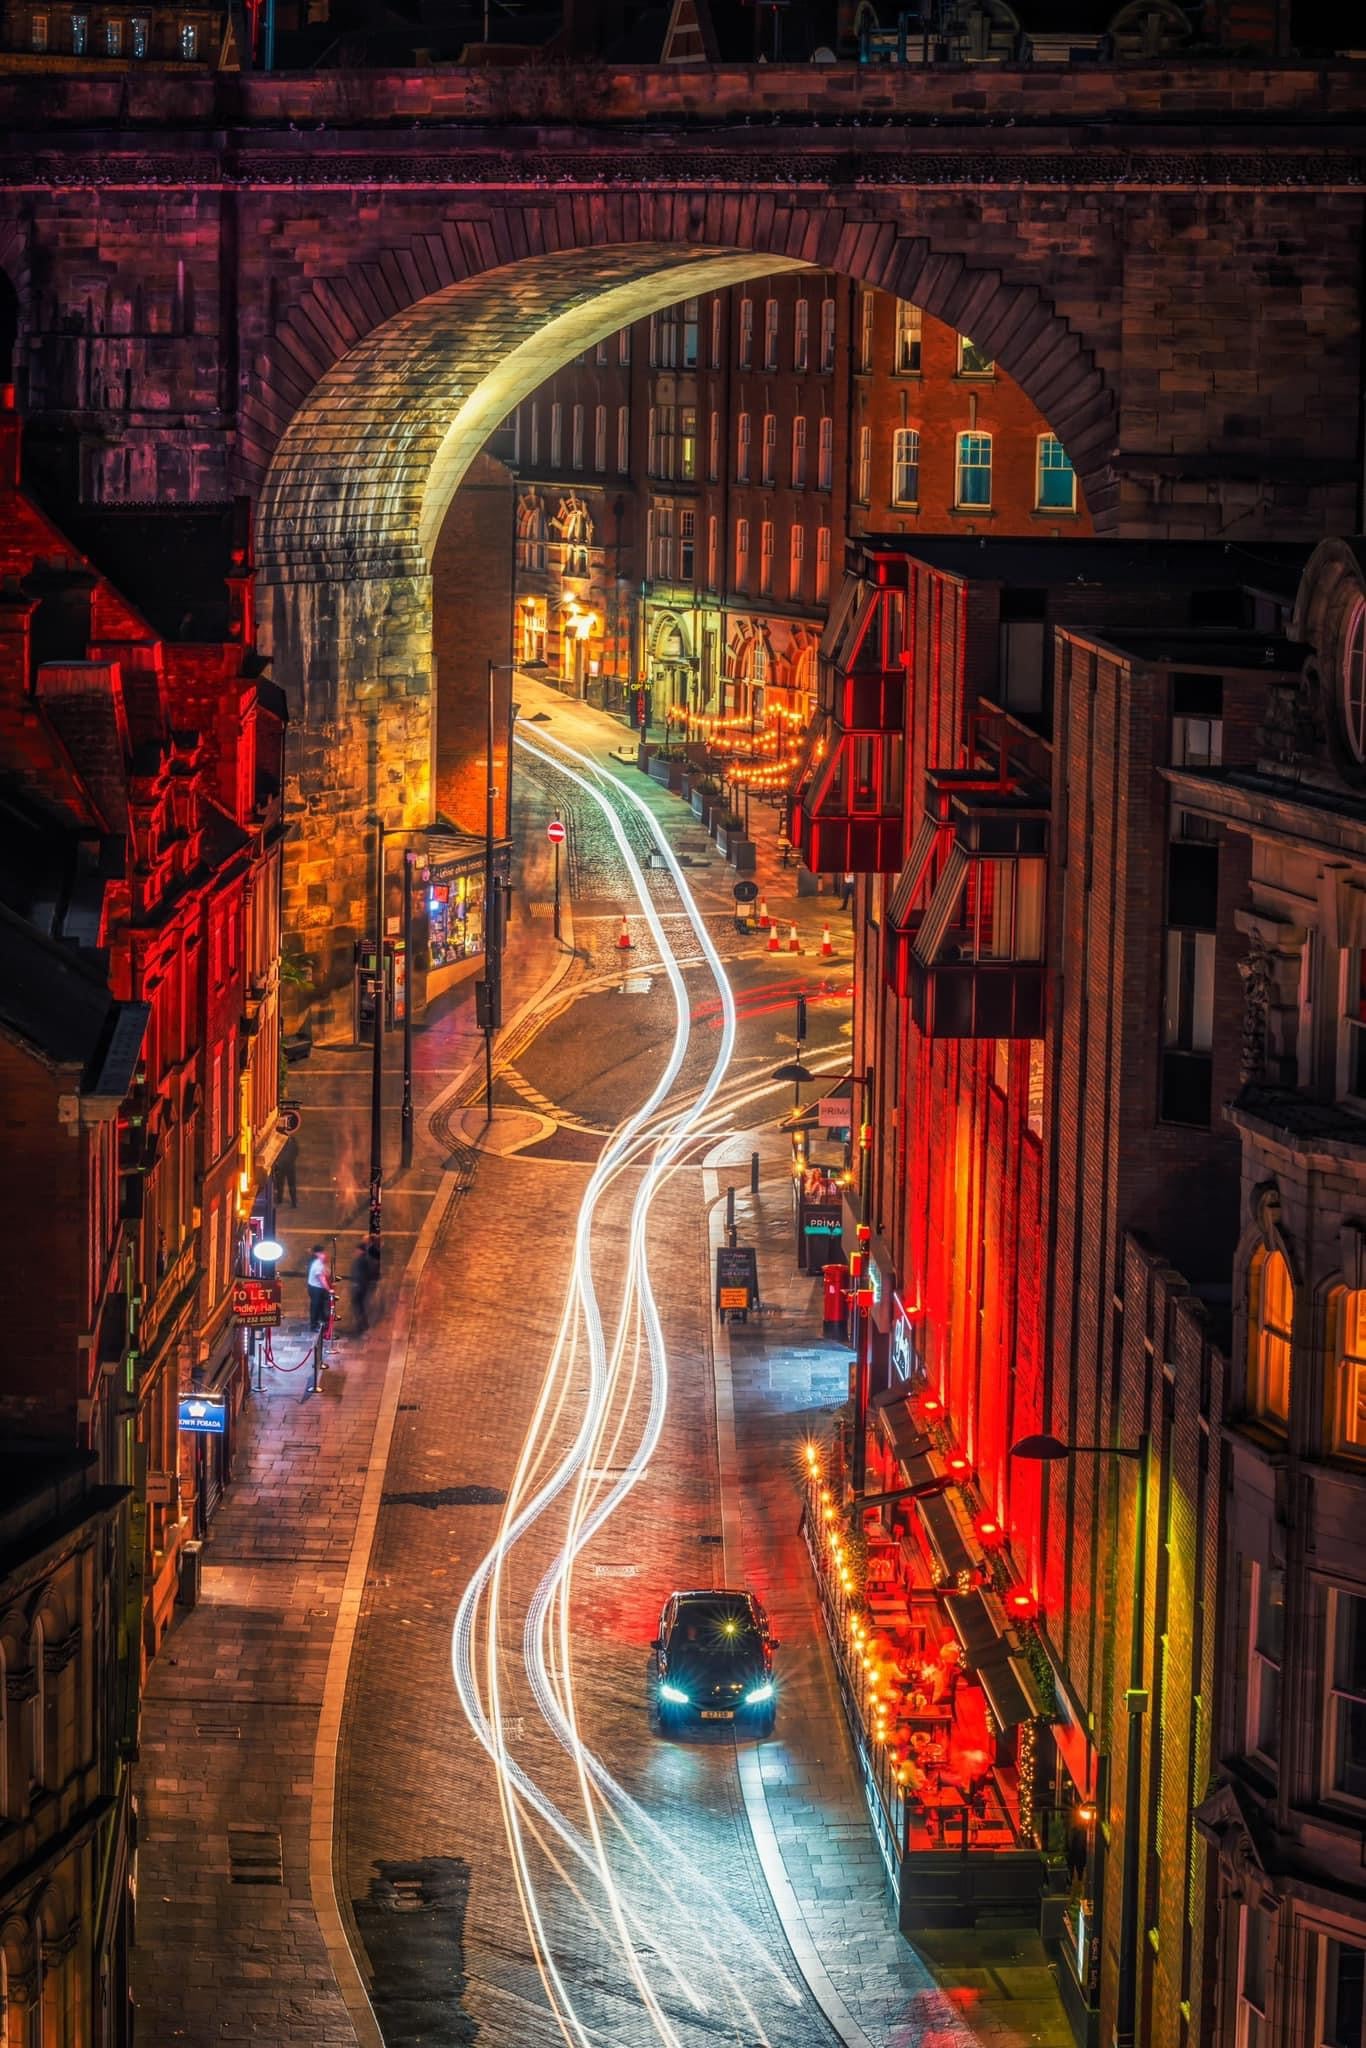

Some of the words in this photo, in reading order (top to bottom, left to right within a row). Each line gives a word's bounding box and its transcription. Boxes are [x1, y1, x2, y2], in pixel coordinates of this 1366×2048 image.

[810, 1219, 841, 1229] PRIMA
[234, 1290, 247, 1302] TO
[250, 1289, 273, 1300] LET
[233, 1304, 258, 1314] adley
